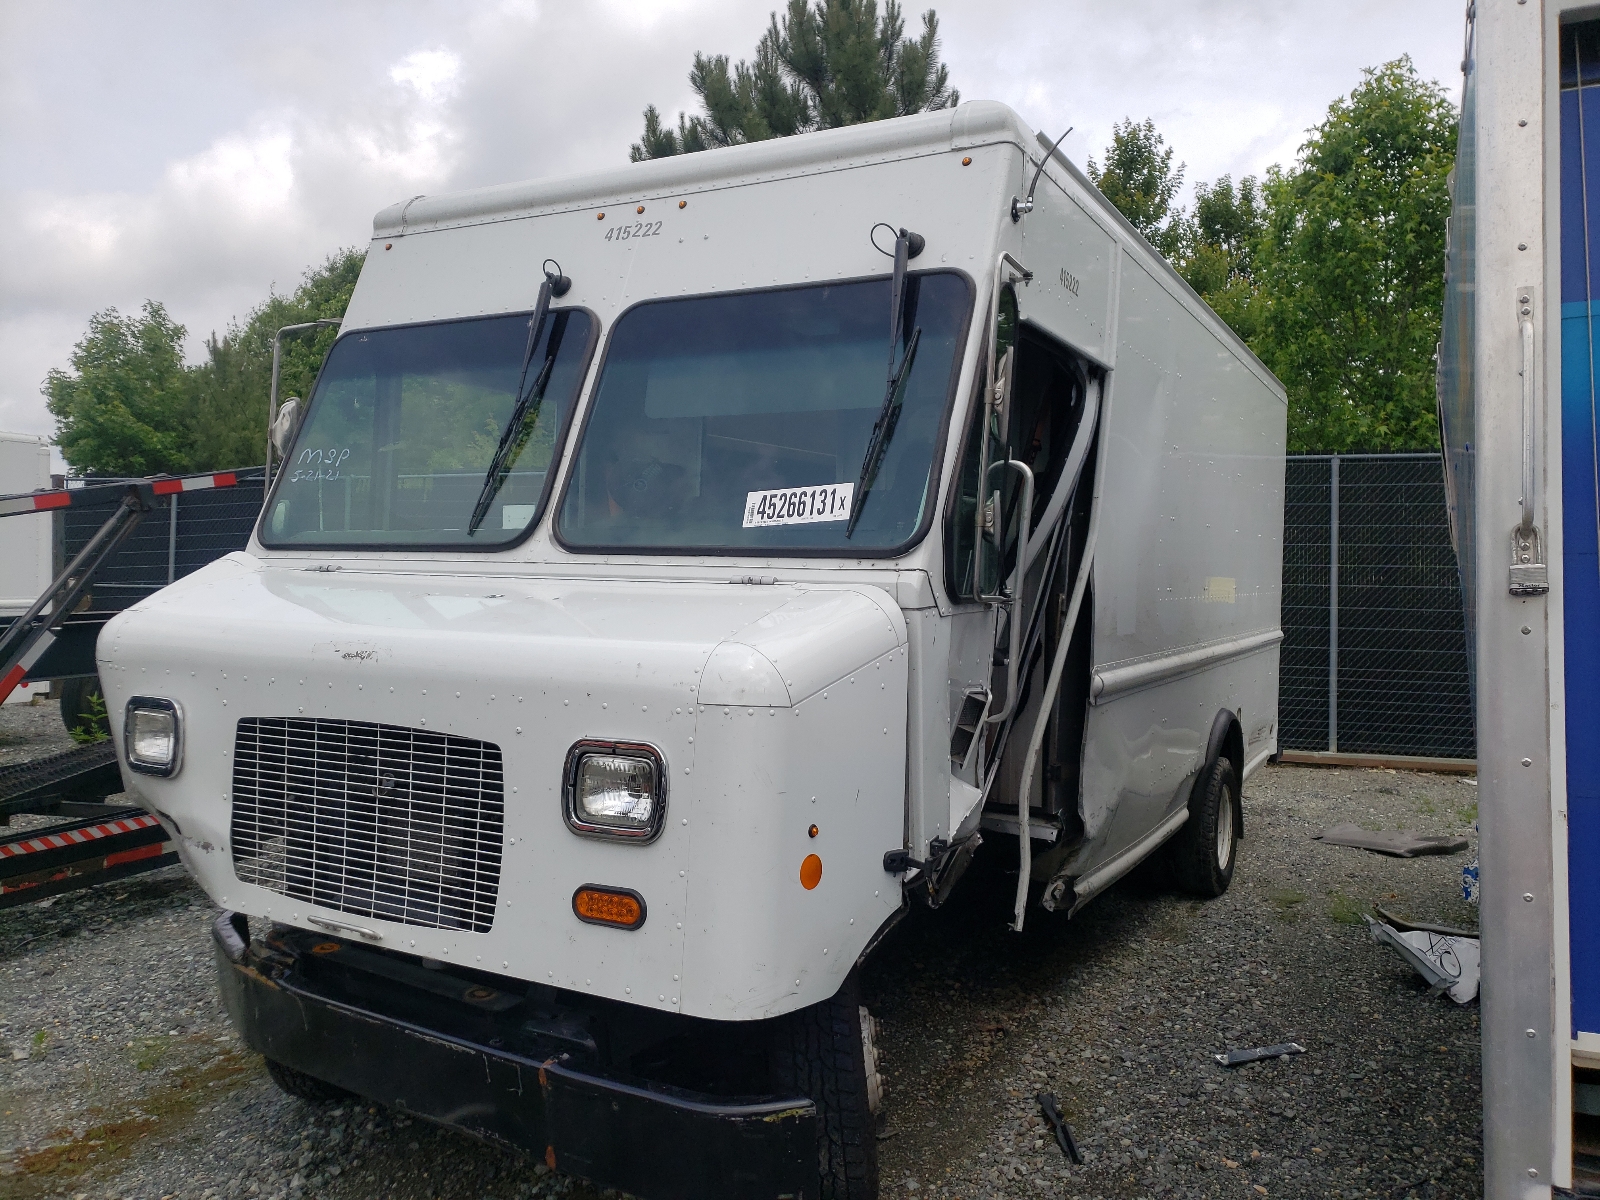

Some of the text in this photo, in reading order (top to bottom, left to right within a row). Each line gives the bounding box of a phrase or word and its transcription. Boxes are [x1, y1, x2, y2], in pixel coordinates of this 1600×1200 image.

[605, 221, 662, 241] 415222
[1060, 268, 1079, 297] 415222
[757, 488, 837, 520] 45266131
